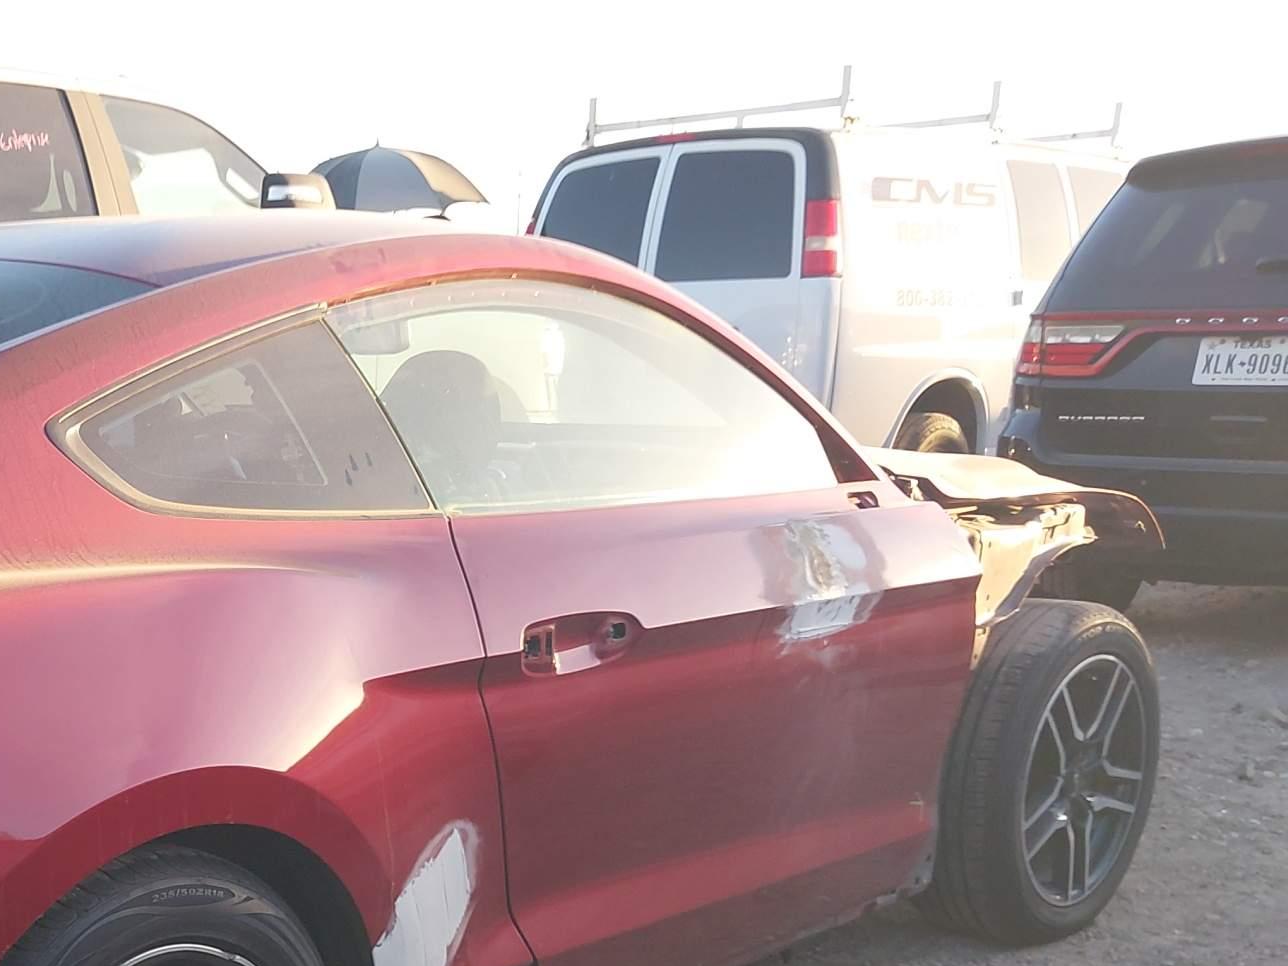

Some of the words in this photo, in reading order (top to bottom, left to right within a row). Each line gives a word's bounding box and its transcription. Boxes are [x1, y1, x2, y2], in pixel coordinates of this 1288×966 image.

[871, 177, 997, 207] CMS
[1234, 338, 1272, 349] TEXAS
[152, 887, 225, 903] 235/50ZR18
